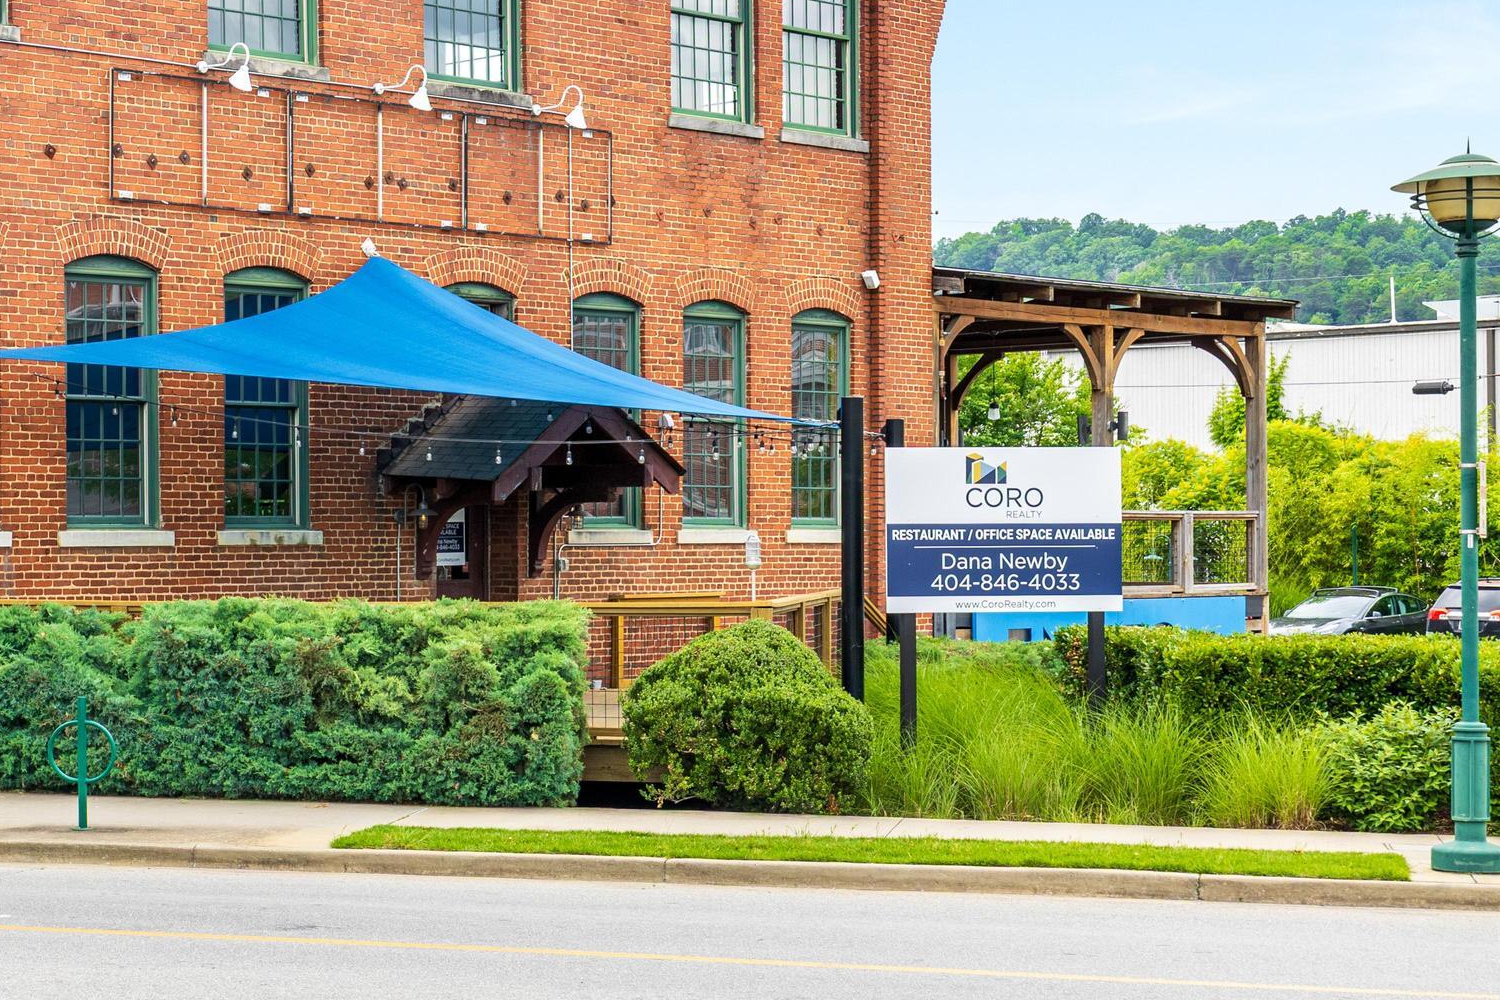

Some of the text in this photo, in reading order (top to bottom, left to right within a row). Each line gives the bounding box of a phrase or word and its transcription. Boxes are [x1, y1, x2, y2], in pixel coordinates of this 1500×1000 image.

[966, 487, 1044, 508] CORO
[1006, 510, 1043, 519] REALTY
[892, 529, 967, 541] RESTAURANT
[975, 529, 1014, 541] OFFICE
[1016, 528, 1053, 540] SPACE
[1054, 528, 1116, 540] AVAILABLE
[941, 552, 1068, 573] Dana Newby
[930, 573, 1080, 591] 404-846-4033
[955, 599, 1056, 610] www.CoroRealty.com
